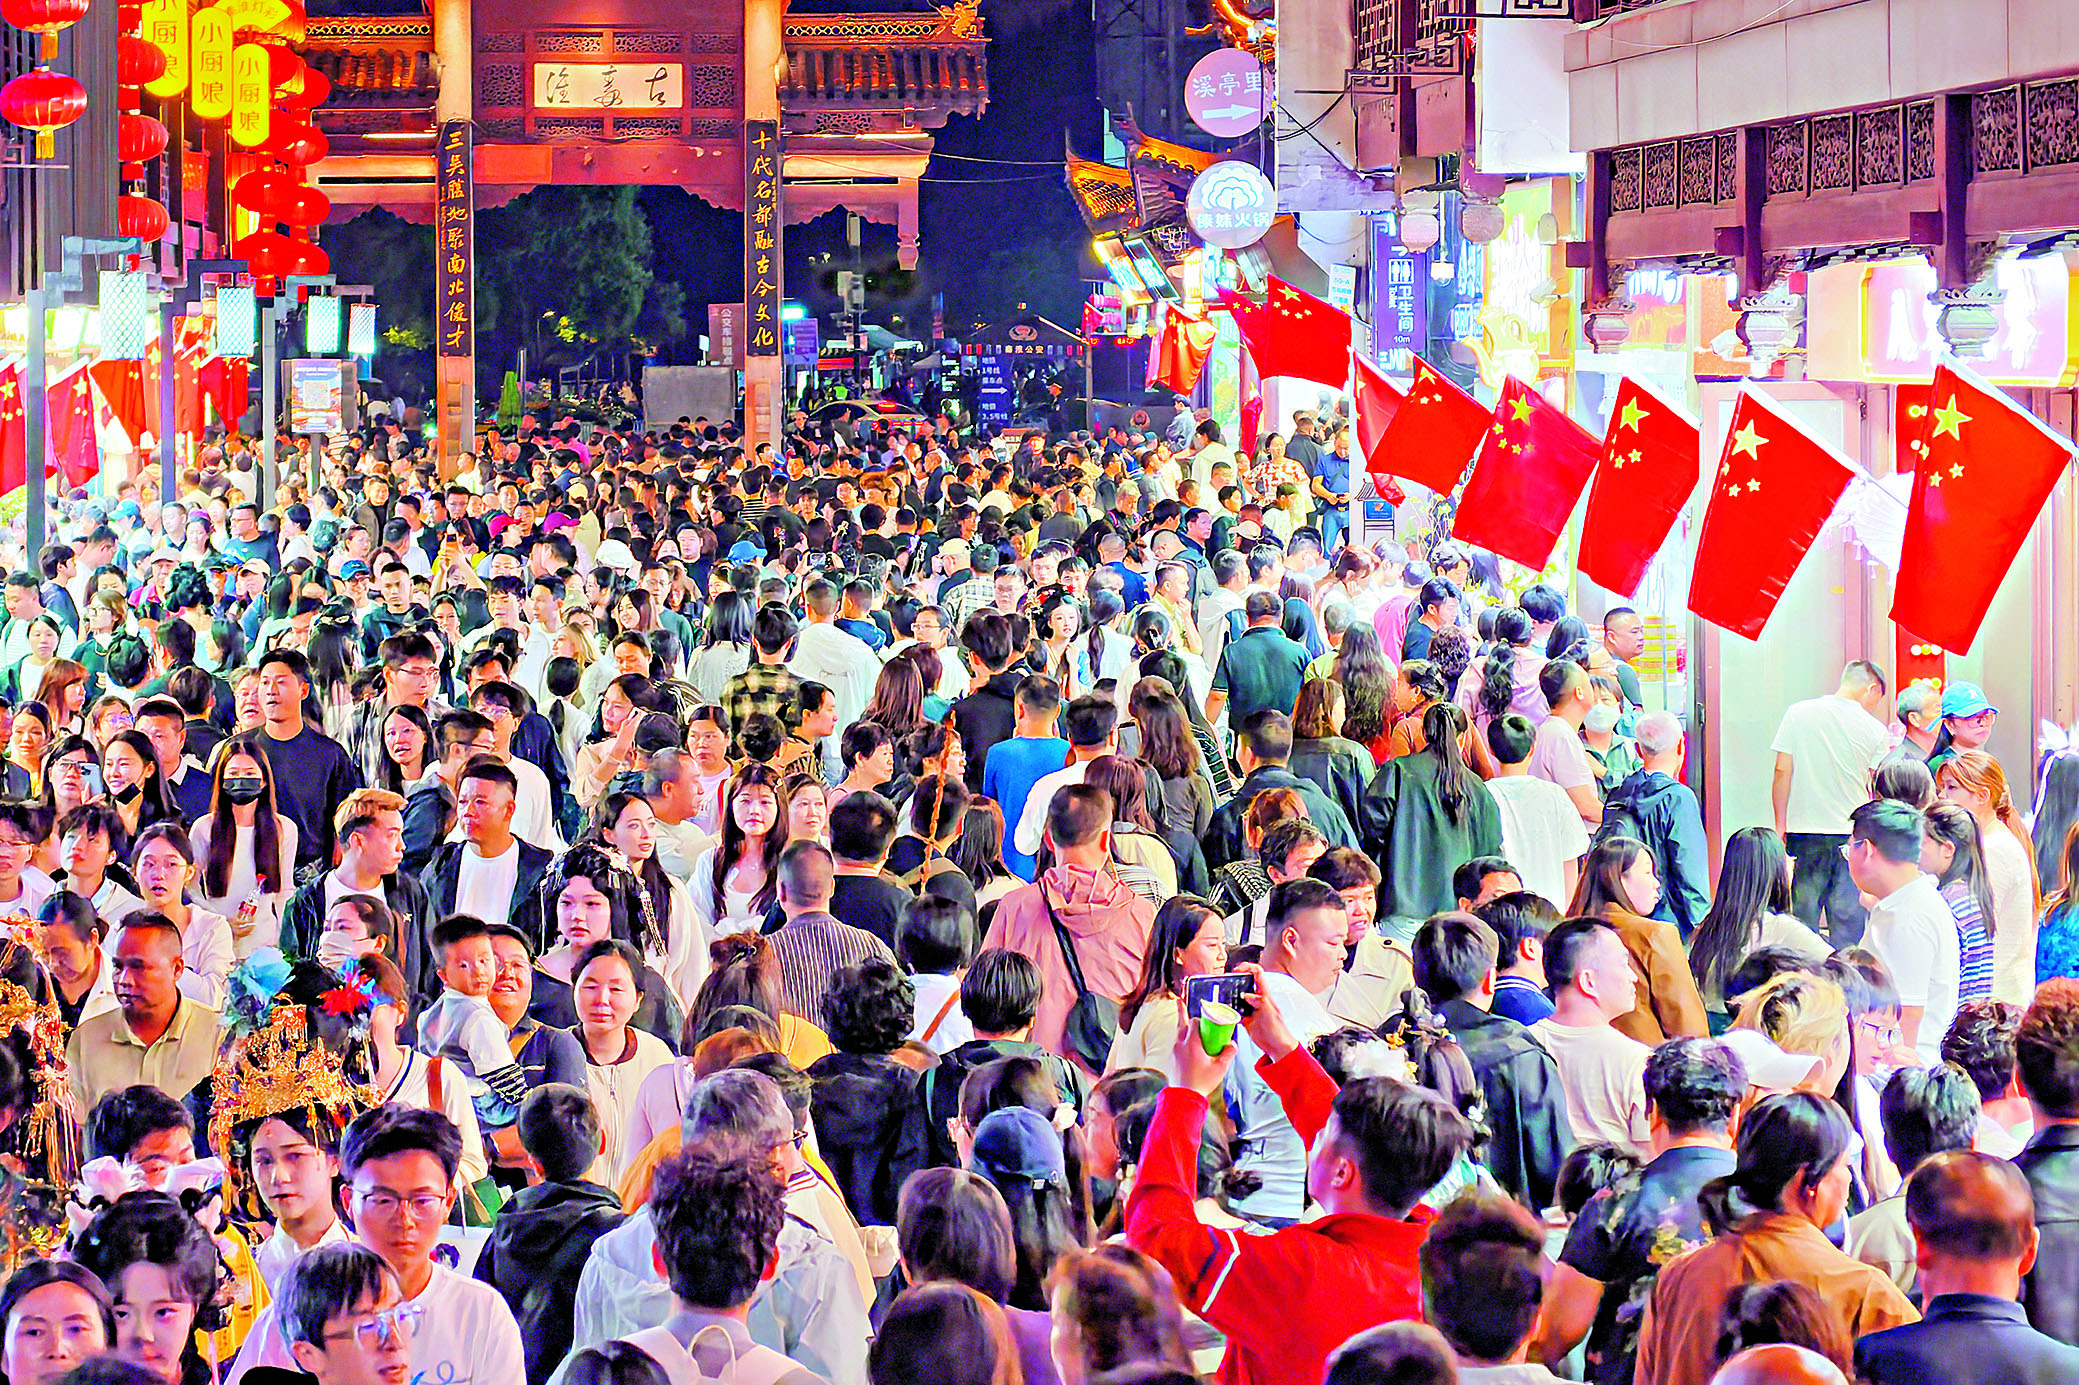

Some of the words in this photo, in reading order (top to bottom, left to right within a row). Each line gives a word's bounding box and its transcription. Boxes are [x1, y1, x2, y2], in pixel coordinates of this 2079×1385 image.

[200, 22, 224, 104] 小厨娘
[1192, 71, 1262, 98] 溪亭里
[239, 57, 261, 131] 小厨娘
[751, 130, 776, 347] 十代名都融古今文化
[1393, 335, 1411, 344] 10m
[1397, 285, 1415, 333] 卫生间
